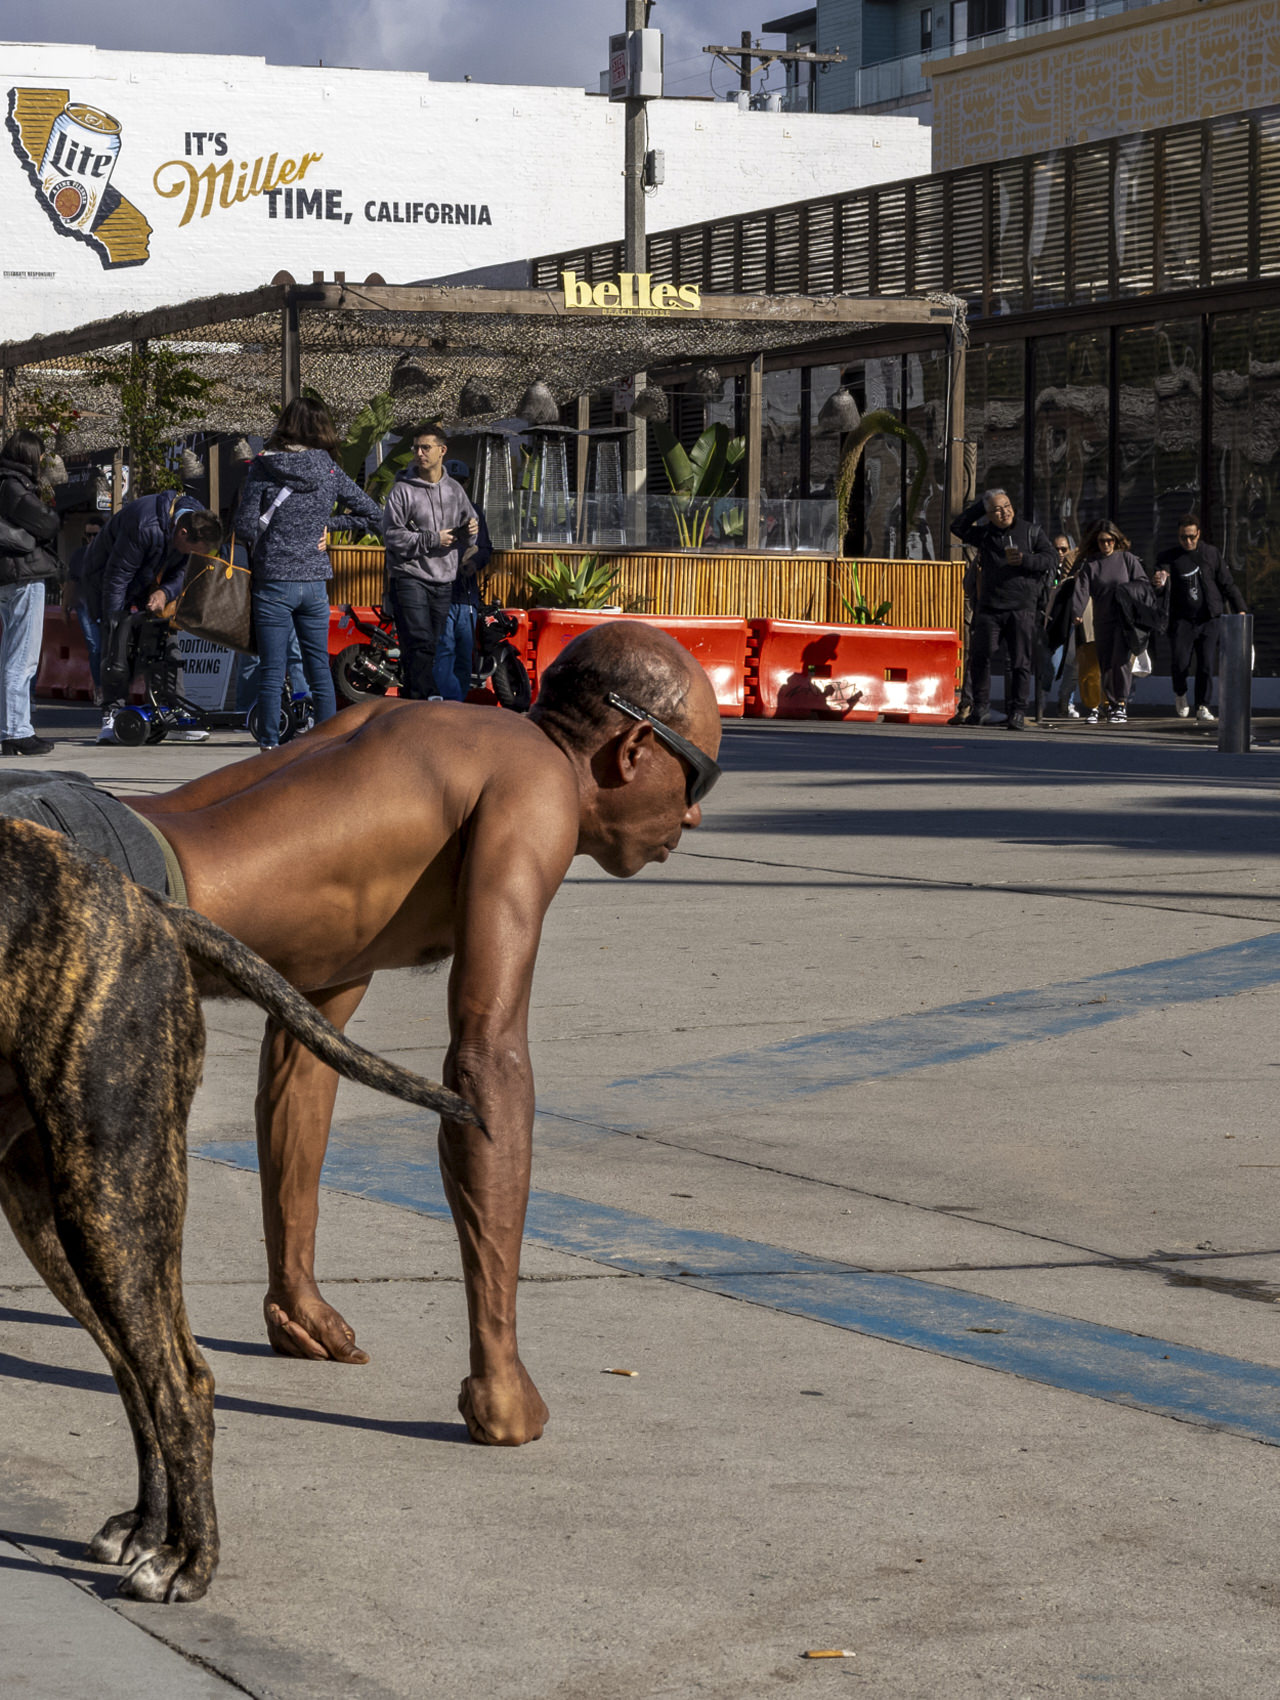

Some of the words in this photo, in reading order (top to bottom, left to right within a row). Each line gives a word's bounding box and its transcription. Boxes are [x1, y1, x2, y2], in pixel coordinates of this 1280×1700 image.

[49, 130, 113, 178] Lite
[184, 131, 229, 156] IT'S
[152, 151, 324, 228] Miller
[263, 187, 353, 225] TIME,
[364, 200, 493, 226] CALIFORNIA
[561, 271, 702, 311] belles
[640, 309, 671, 317] HOUSE
[179, 639, 229, 654] DDITIONA
[183, 659, 221, 674] ARKING
